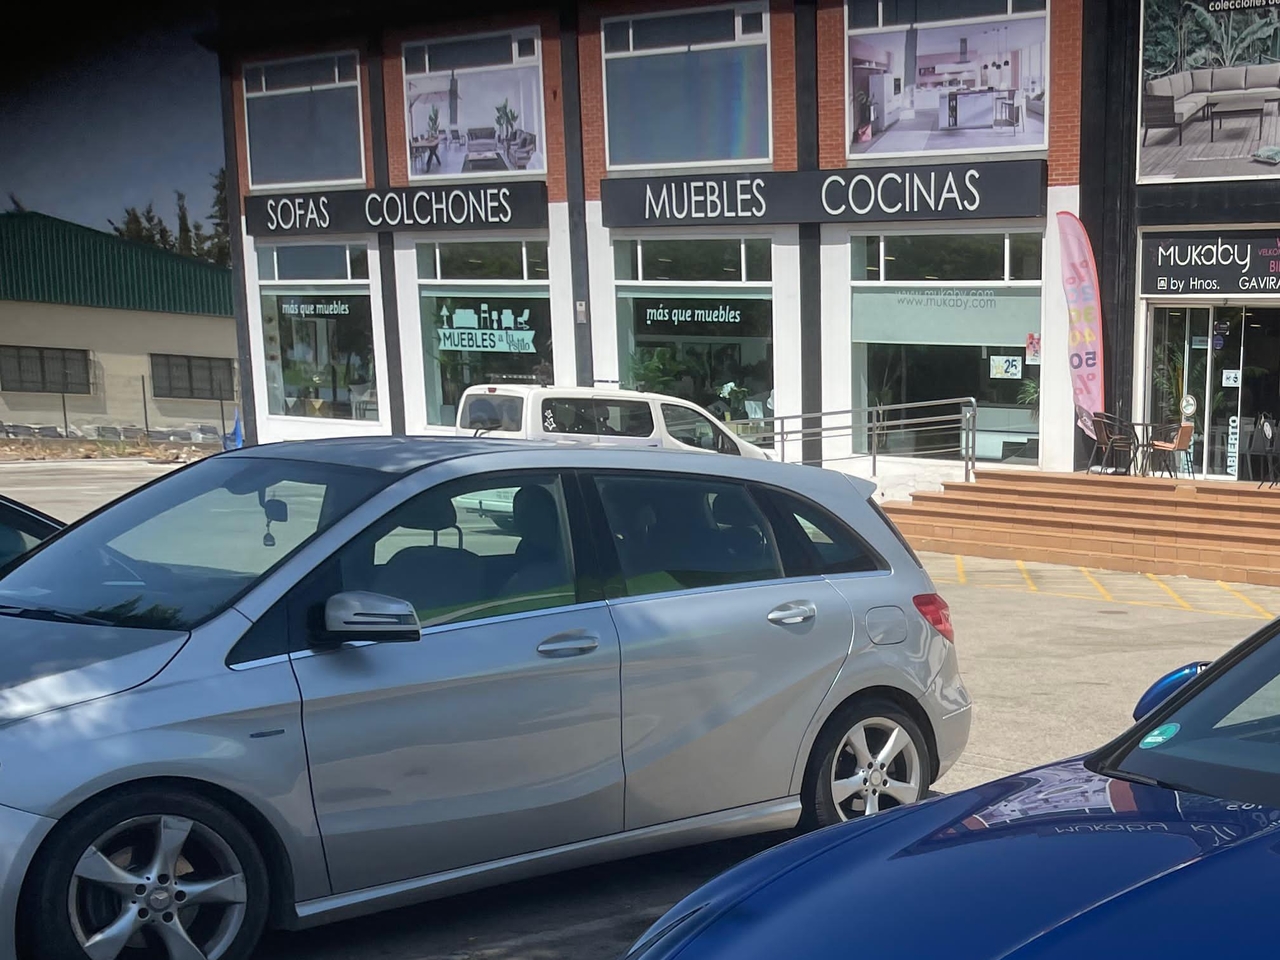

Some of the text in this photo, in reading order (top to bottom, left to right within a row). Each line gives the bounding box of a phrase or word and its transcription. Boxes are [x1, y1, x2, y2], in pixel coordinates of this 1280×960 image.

[645, 169, 980, 219] MUEBLES COCINAS
[267, 187, 512, 230] SOFAS COLCHONES
[1170, 278, 1184, 291] by
[1190, 278, 1220, 290] Hnos.
[282, 300, 349, 318] más que muebles
[646, 304, 741, 325] más que muebles
[443, 332, 496, 348] MUEBLES
[1227, 415, 1238, 476] ABIERTO
